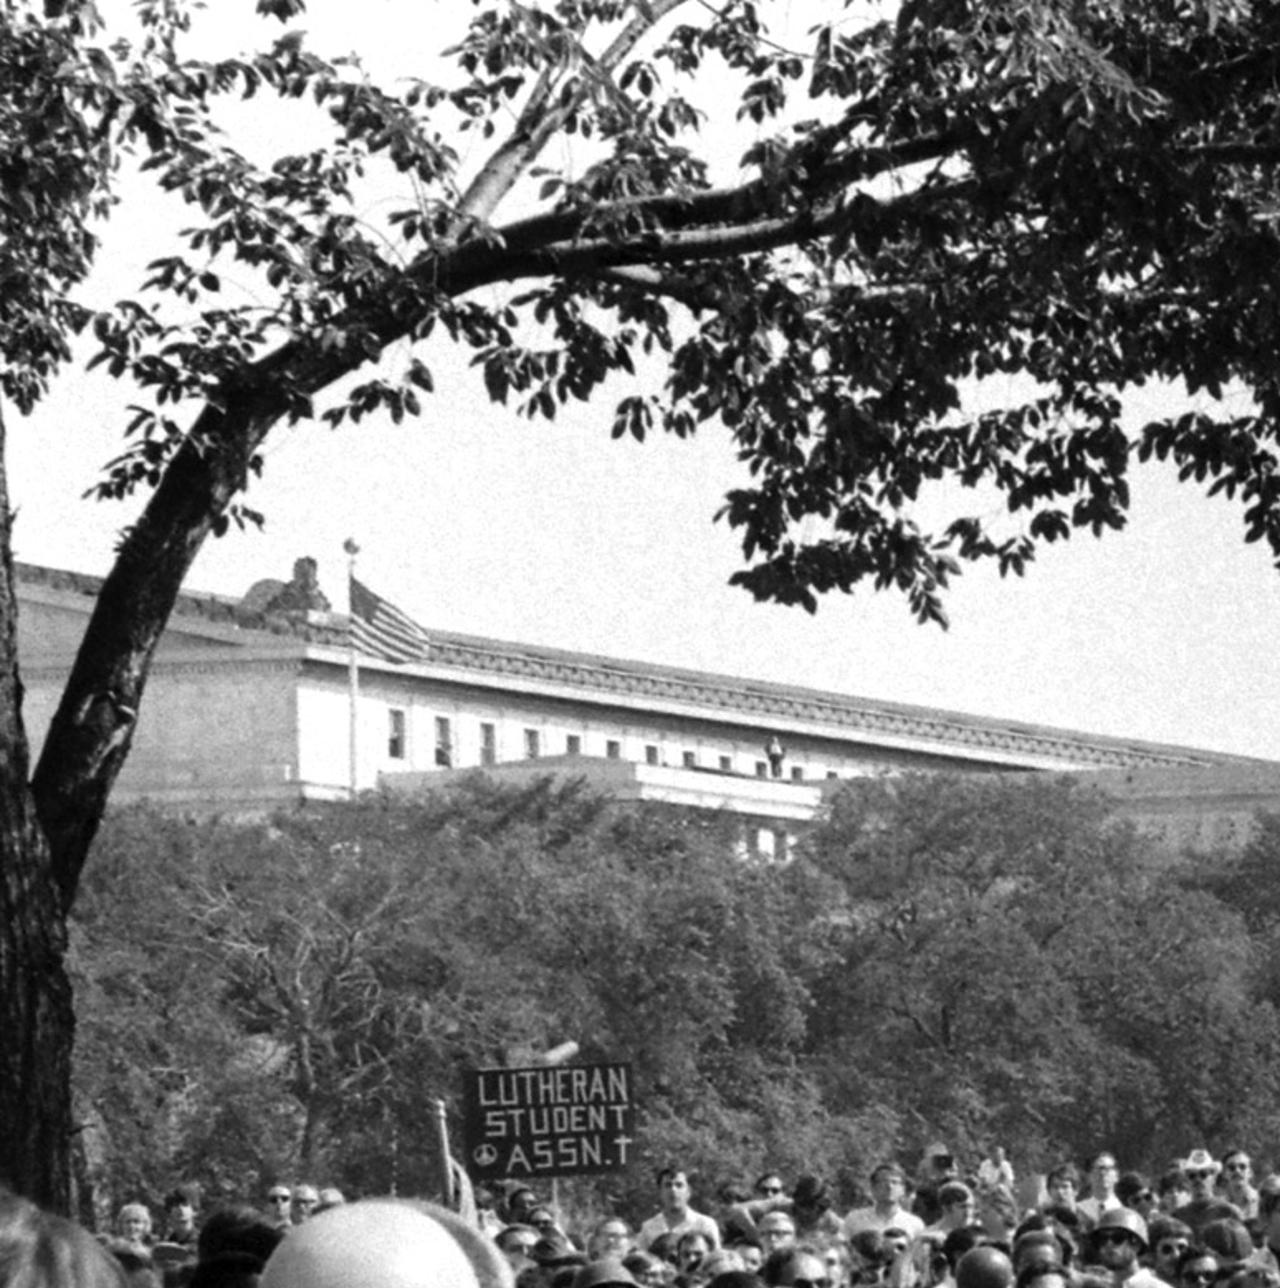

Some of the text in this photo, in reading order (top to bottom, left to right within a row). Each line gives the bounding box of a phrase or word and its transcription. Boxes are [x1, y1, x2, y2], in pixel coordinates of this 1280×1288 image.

[478, 1067, 629, 1106] LUTHERAN
[486, 1104, 629, 1137] STUDENT
[506, 1135, 613, 1173] ASSN.
